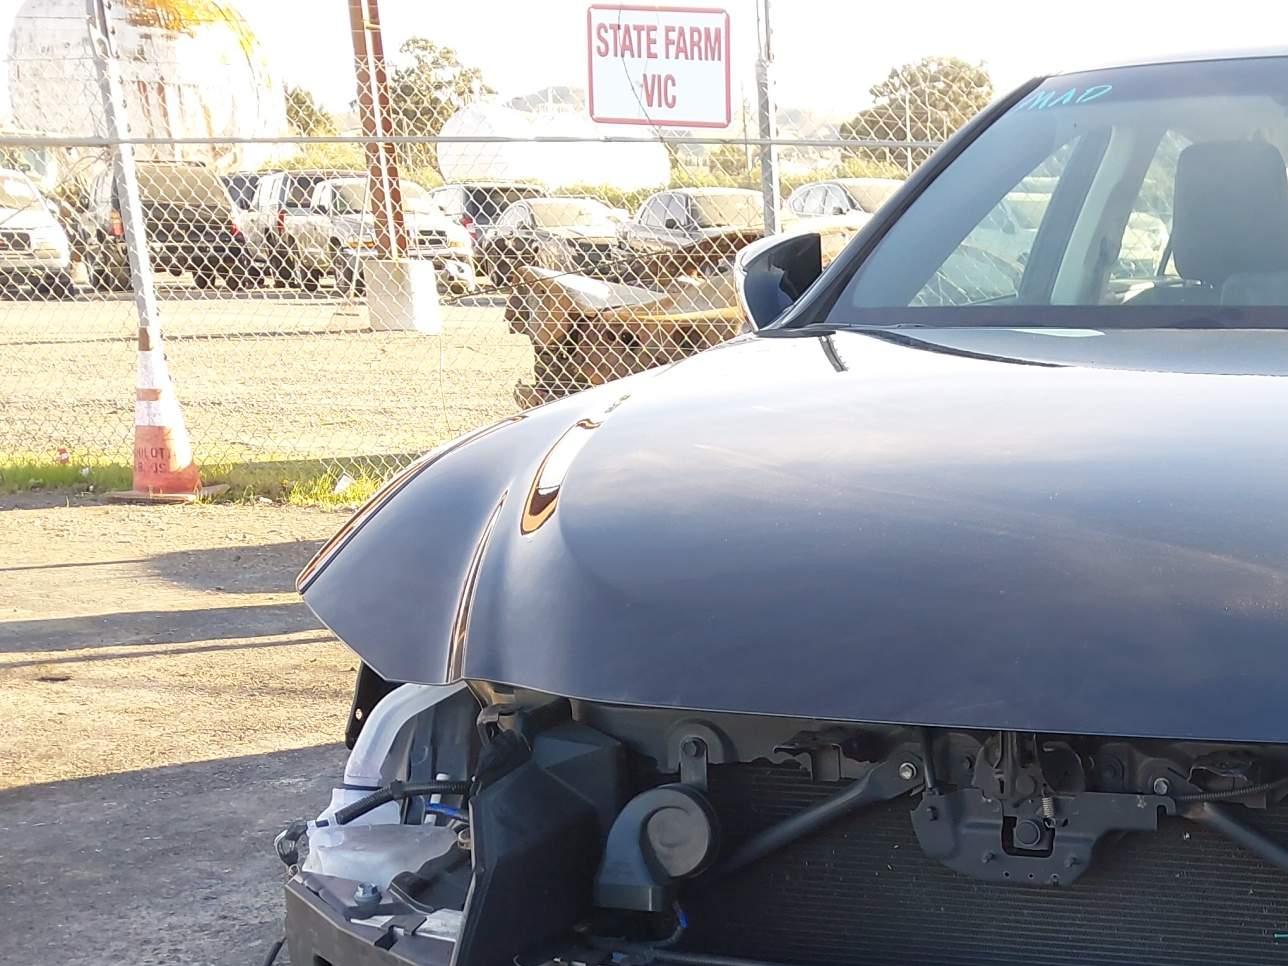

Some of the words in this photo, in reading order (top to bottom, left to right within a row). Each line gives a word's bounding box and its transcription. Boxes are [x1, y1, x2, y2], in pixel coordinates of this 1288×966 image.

[596, 22, 659, 59] STATE
[664, 25, 722, 61] FARM
[642, 73, 677, 109] VIC
